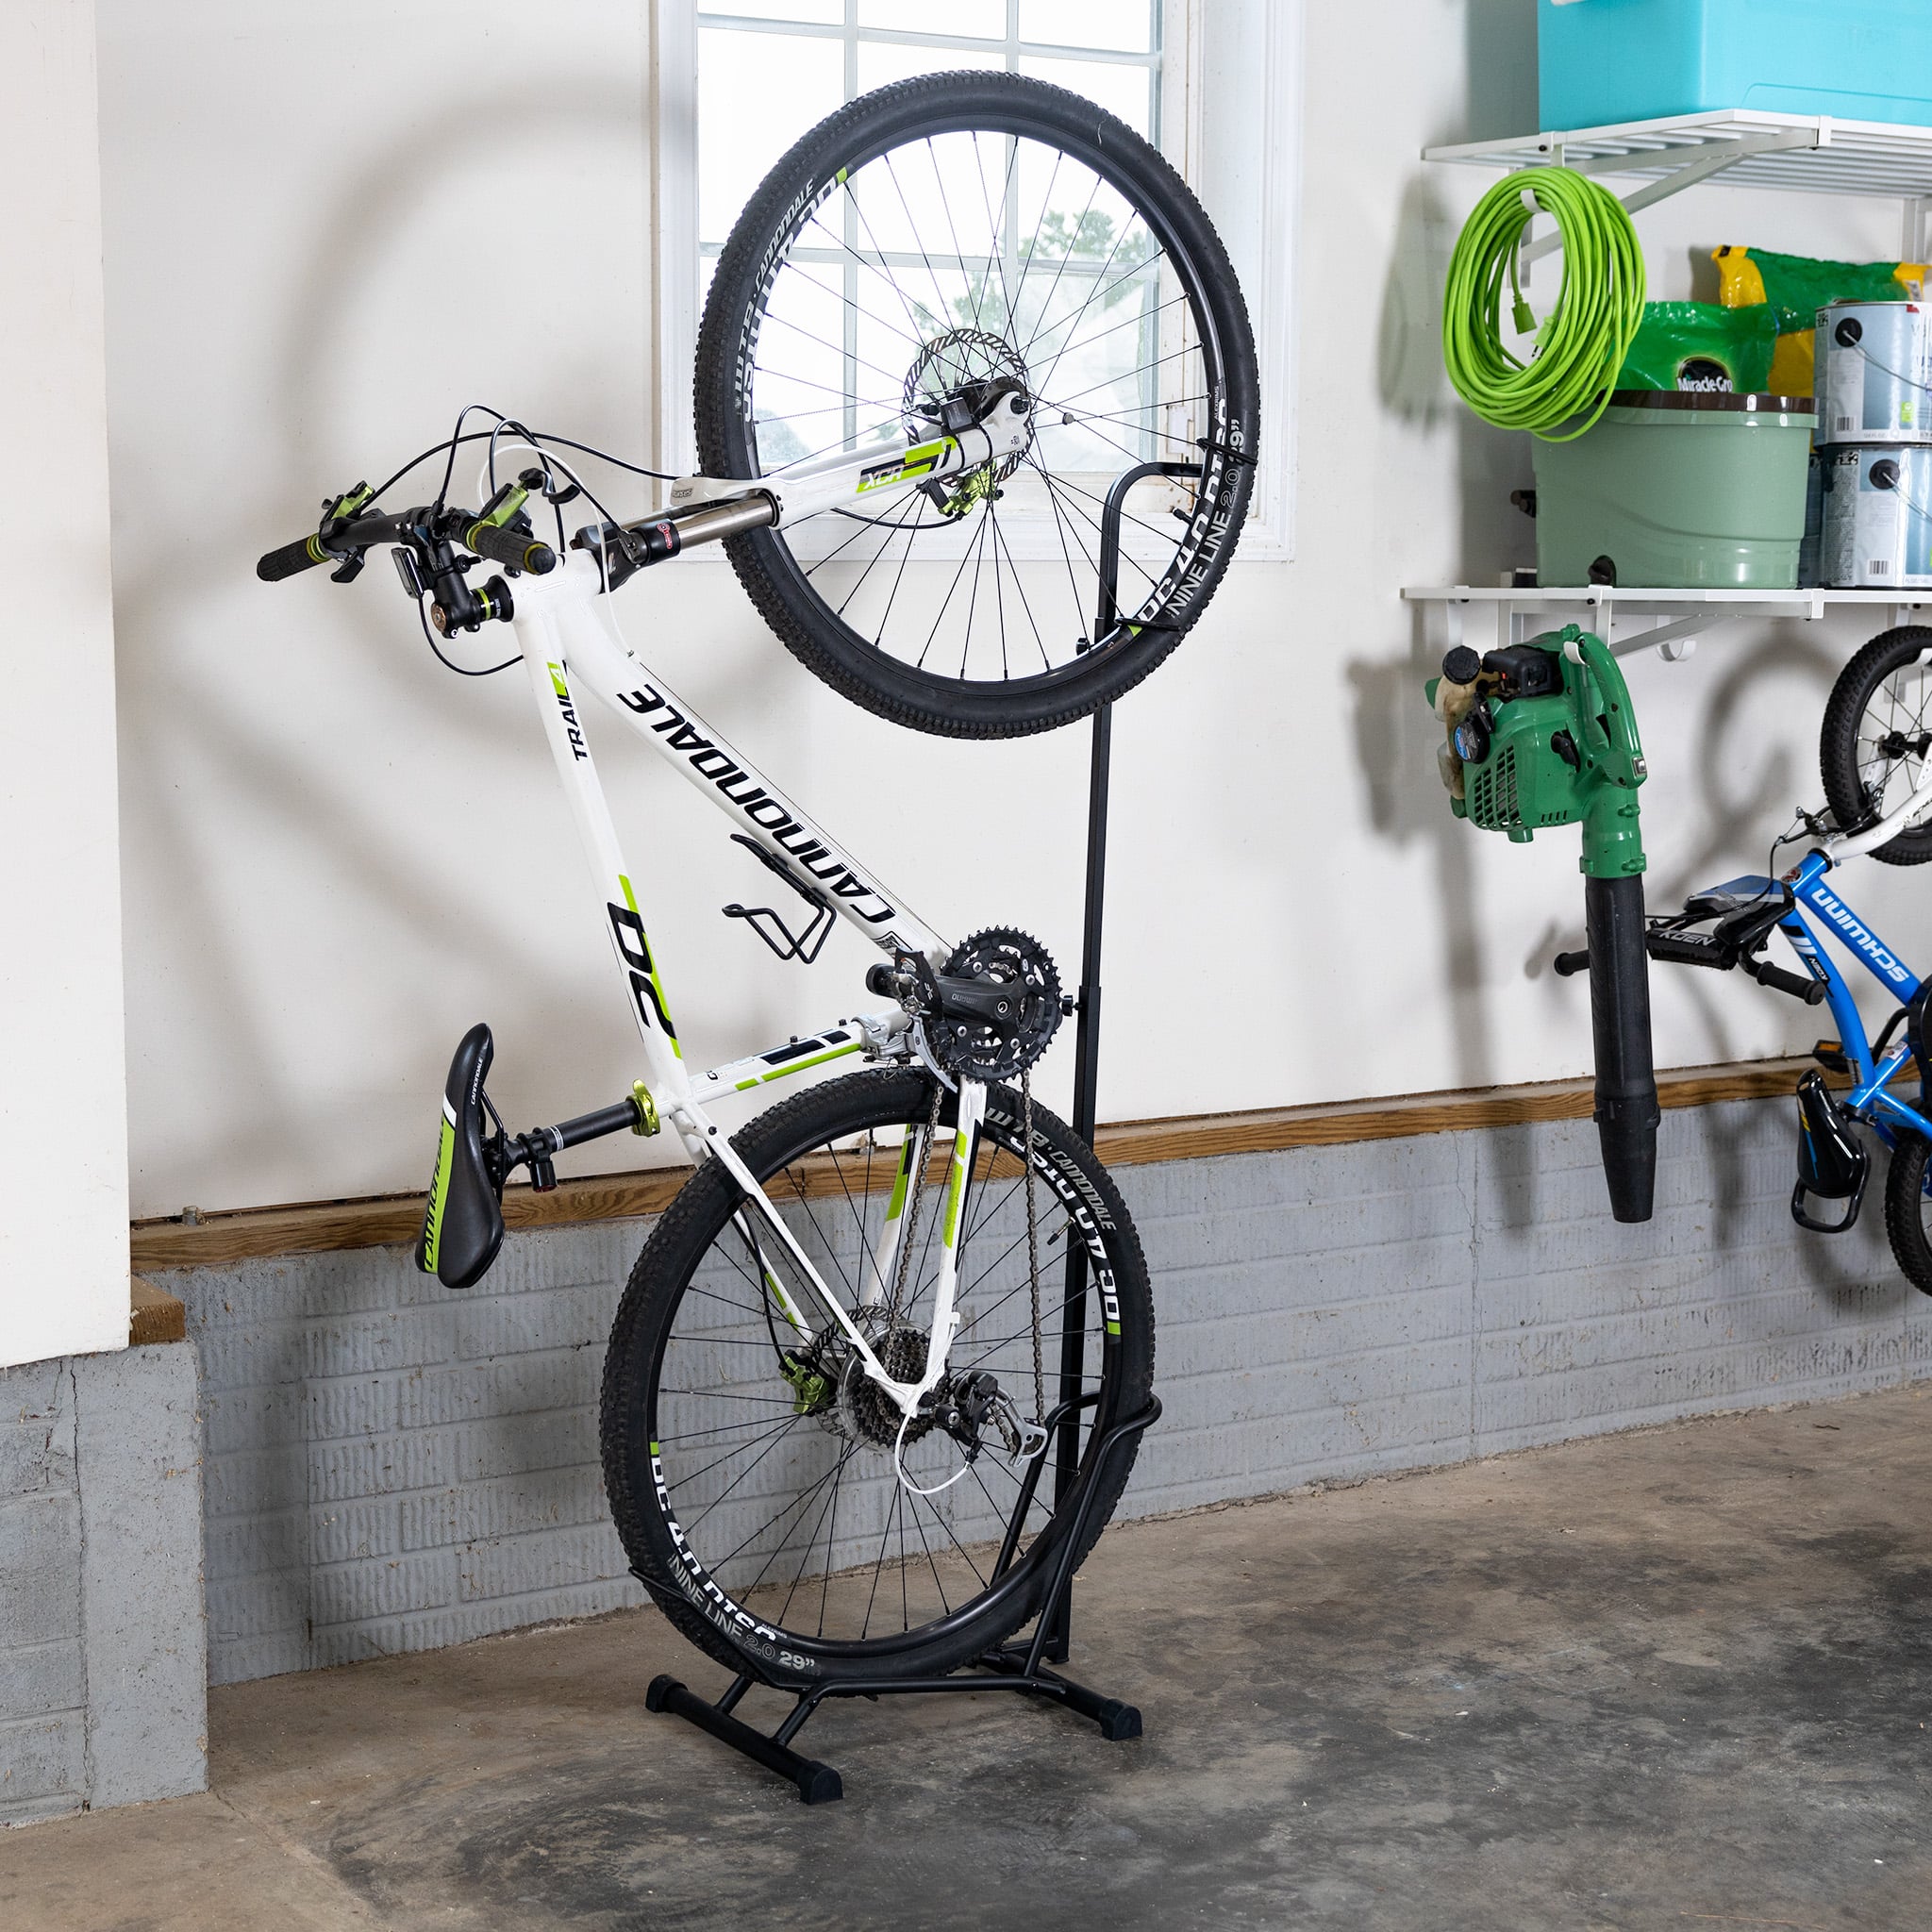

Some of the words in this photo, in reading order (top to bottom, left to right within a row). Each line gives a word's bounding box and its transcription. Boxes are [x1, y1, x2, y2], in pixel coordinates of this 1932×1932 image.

[756, 177, 813, 291] CANNONDALE
[1168, 563, 1208, 617] NINE
[1198, 510, 1232, 563] LINE
[1221, 469, 1241, 508] 2.0
[1137, 576, 1177, 623] DC
[558, 687, 589, 761] TRAIL
[616, 684, 896, 924] CANNONDALE
[1659, 929, 1717, 947] KOEN
[1811, 888, 1909, 983] SCHWINN
[1049, 1151, 1117, 1230] CANNONDALE
[651, 1457, 671, 1511] DC
[669, 1555, 706, 1607] NINE
[705, 1602, 743, 1640] LINE
[743, 1635, 775, 1660] 2.0
